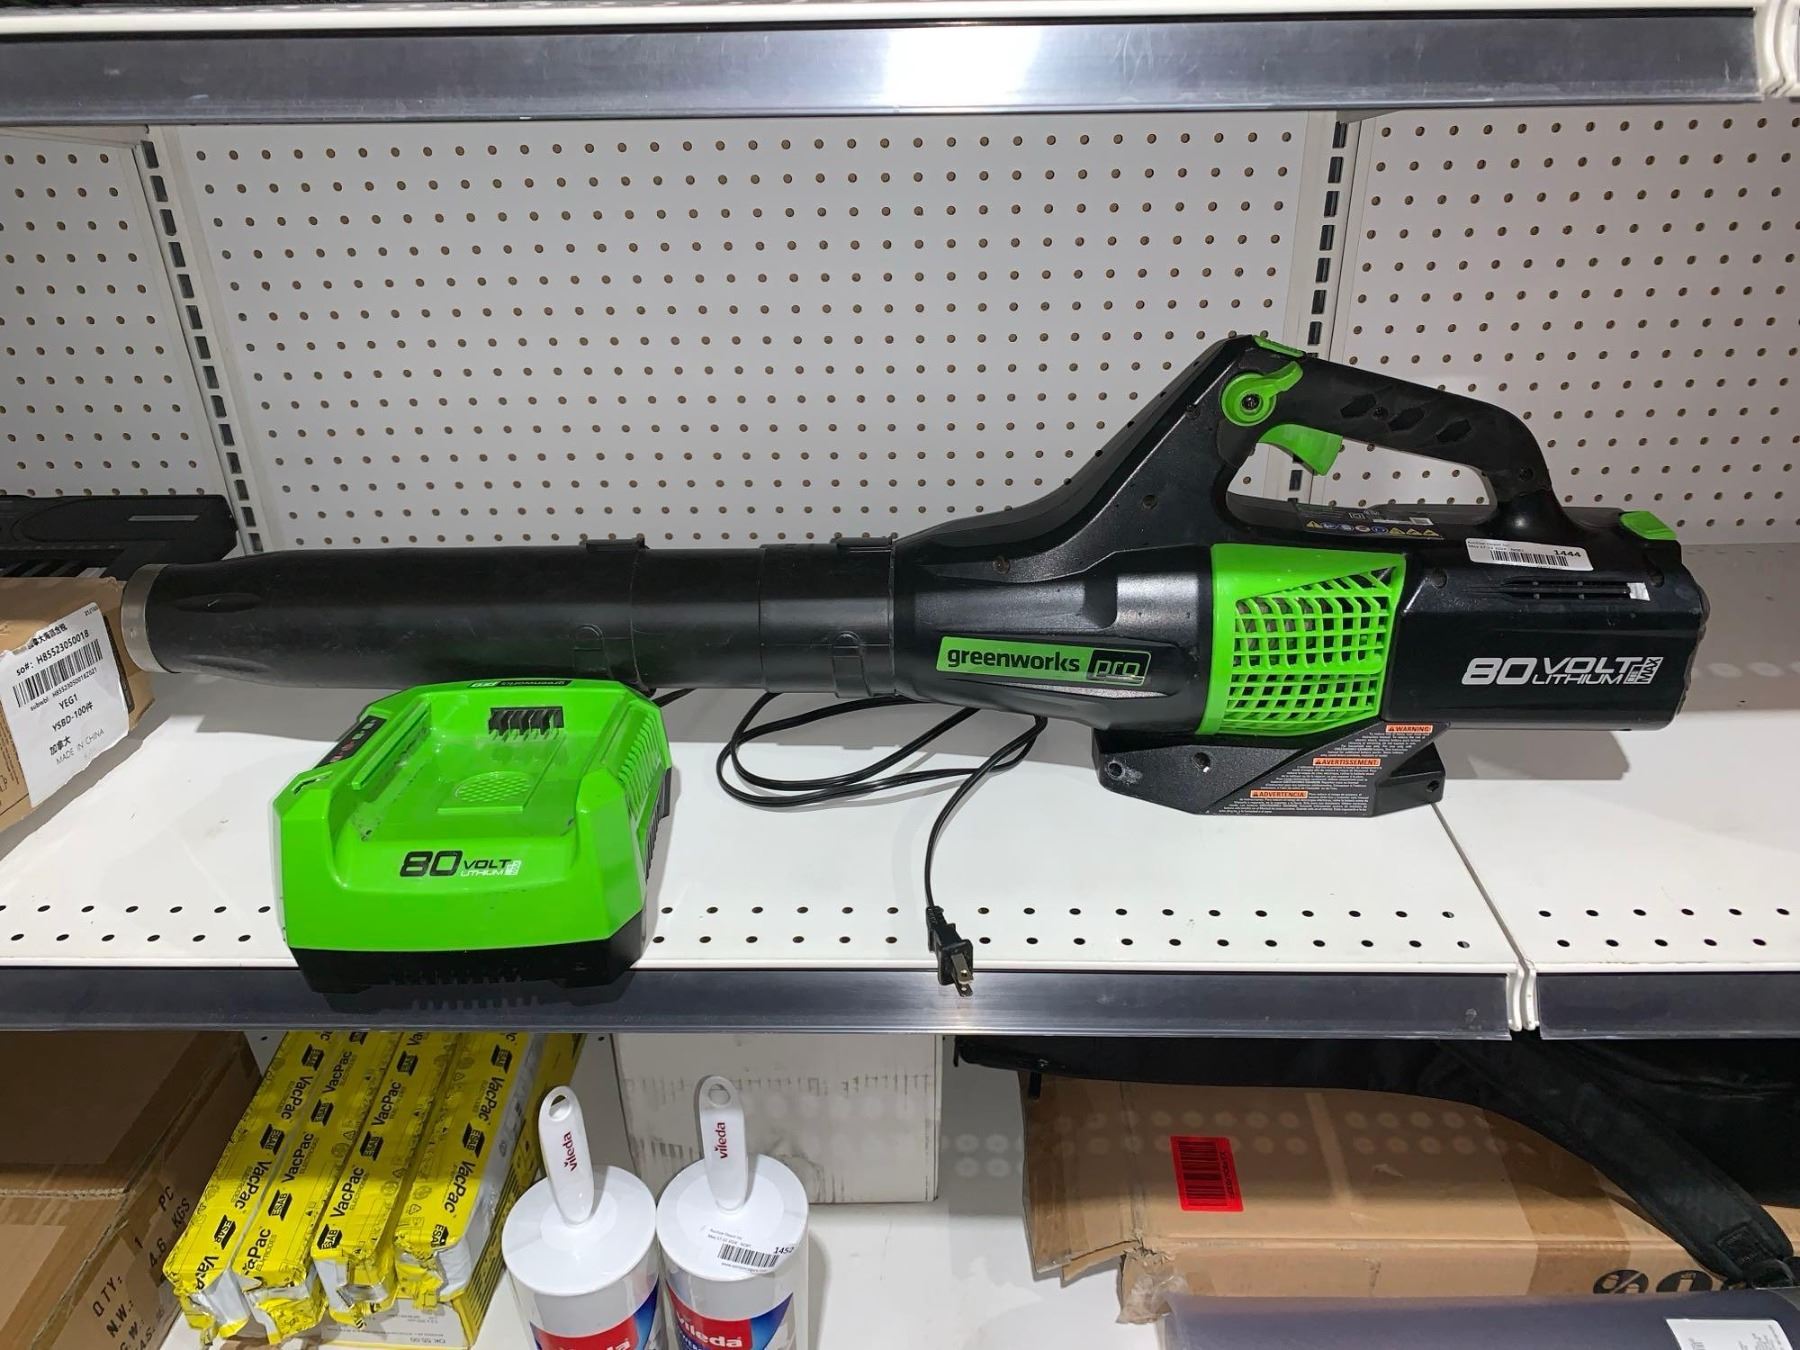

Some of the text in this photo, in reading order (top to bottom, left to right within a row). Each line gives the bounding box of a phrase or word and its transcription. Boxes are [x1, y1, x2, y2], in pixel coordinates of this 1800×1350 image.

[1554, 549, 1582, 558] 1444
[36, 629, 90, 664] H85523050018
[947, 648, 1141, 678] greenworks pro
[1461, 657, 1538, 685] 80
[1543, 656, 1643, 674] VOLT
[1532, 674, 1624, 685] LITHIUM
[58, 694, 78, 710] YEG1
[49, 735, 72, 756] 加拿大
[56, 747, 75, 765] MADE
[85, 728, 105, 746] CHINA
[400, 850, 463, 877] 80
[463, 859, 512, 870] VOLT
[460, 869, 505, 877] LITHIUM
[321, 1050, 353, 1095] VacPac
[281, 1075, 314, 1121] VacPac
[371, 1081, 402, 1127] VacPac
[478, 1076, 505, 1122] VacPac
[281, 1132, 315, 1184] VacPac
[563, 1131, 578, 1172] vileda
[713, 1121, 728, 1160] vileda
[235, 1160, 272, 1210] VacPac
[330, 1166, 364, 1219] VacPac
[444, 1160, 476, 1213] VacPac
[134, 1236, 143, 1249] 1
[158, 1185, 174, 1212] PC
[271, 1192, 290, 1218] ESAB
[149, 1237, 167, 1268] 4.6
[171, 1198, 190, 1229] KGS
[214, 1219, 234, 1244] ESAB
[320, 1228, 339, 1250] ESAB
[676, 1311, 743, 1348] vileda
